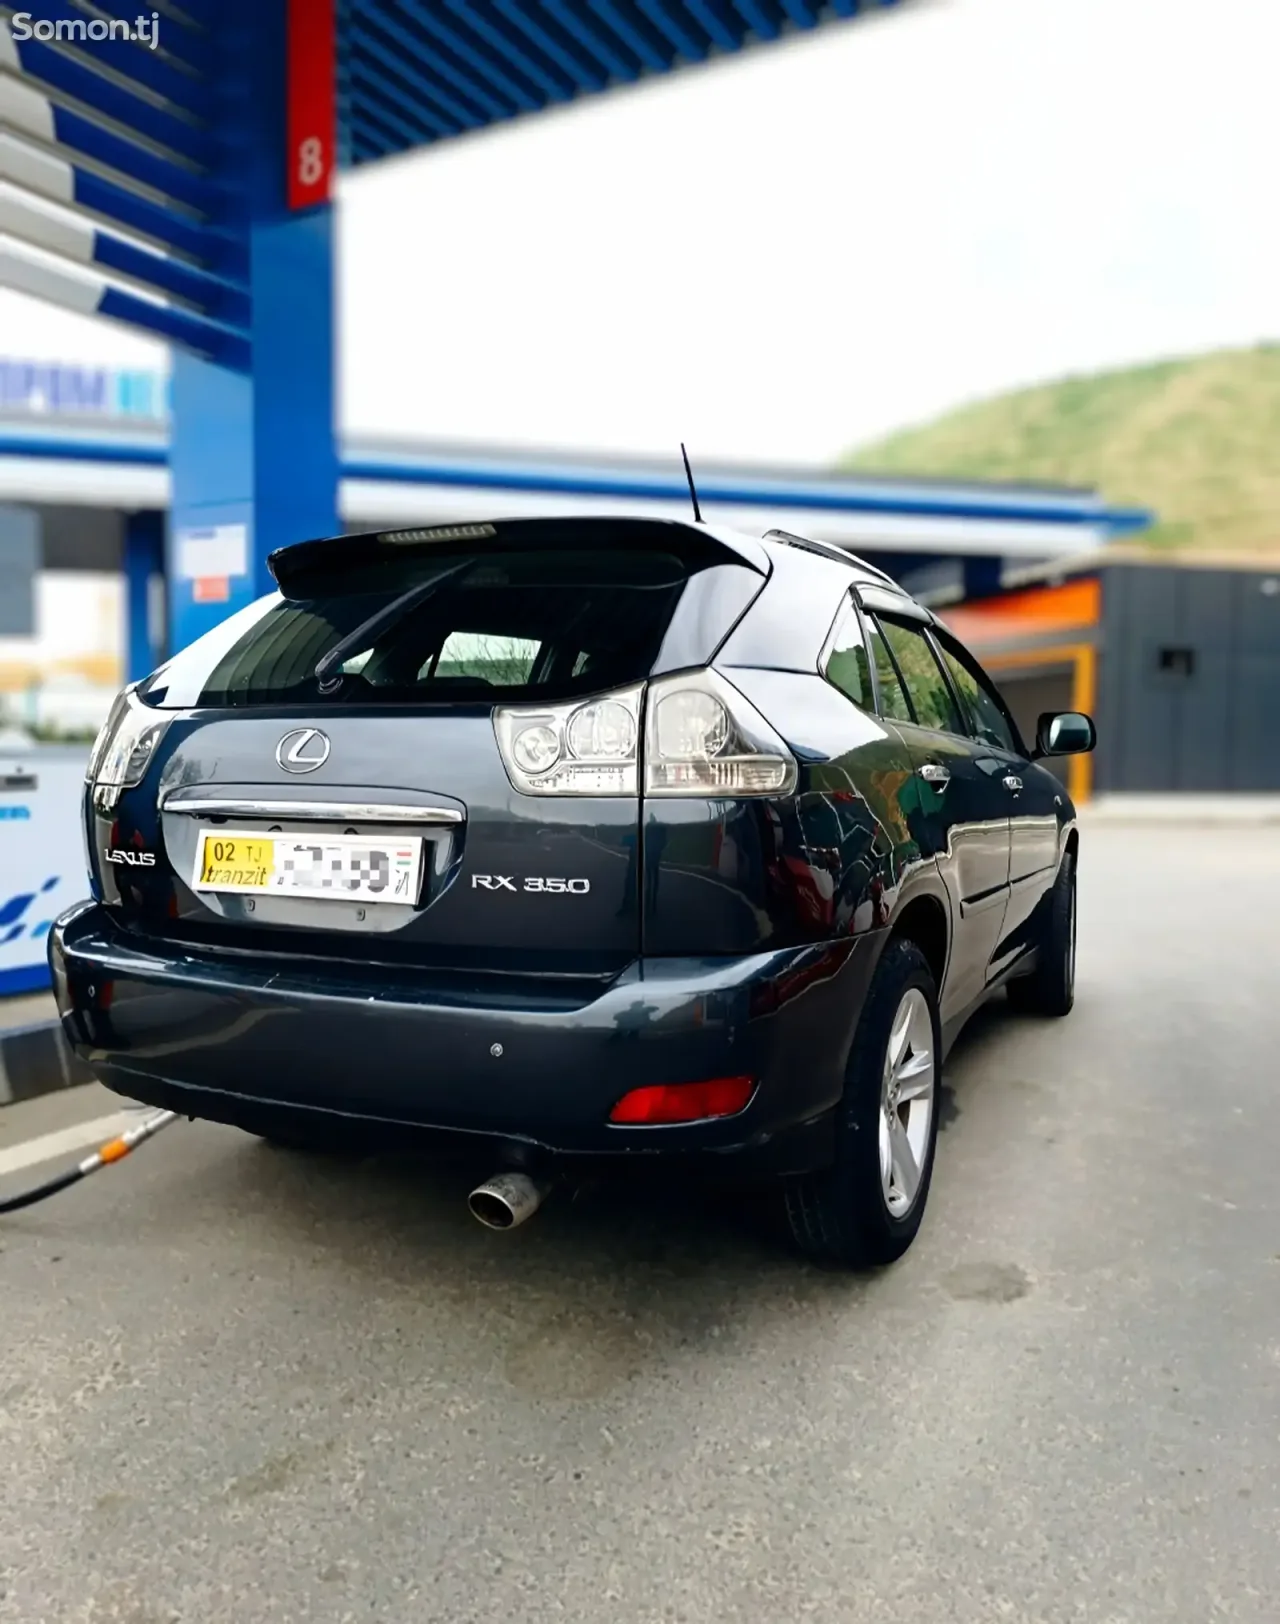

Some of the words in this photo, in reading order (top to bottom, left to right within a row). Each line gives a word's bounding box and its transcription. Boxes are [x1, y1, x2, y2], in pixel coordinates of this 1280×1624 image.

[299, 136, 322, 185] 8
[104, 848, 156, 866] LEXUS
[213, 842, 235, 862] 02
[246, 845, 262, 863] TJ
[205, 865, 267, 886] tranzit
[471, 874, 518, 892] RX
[523, 877, 590, 894] 350
